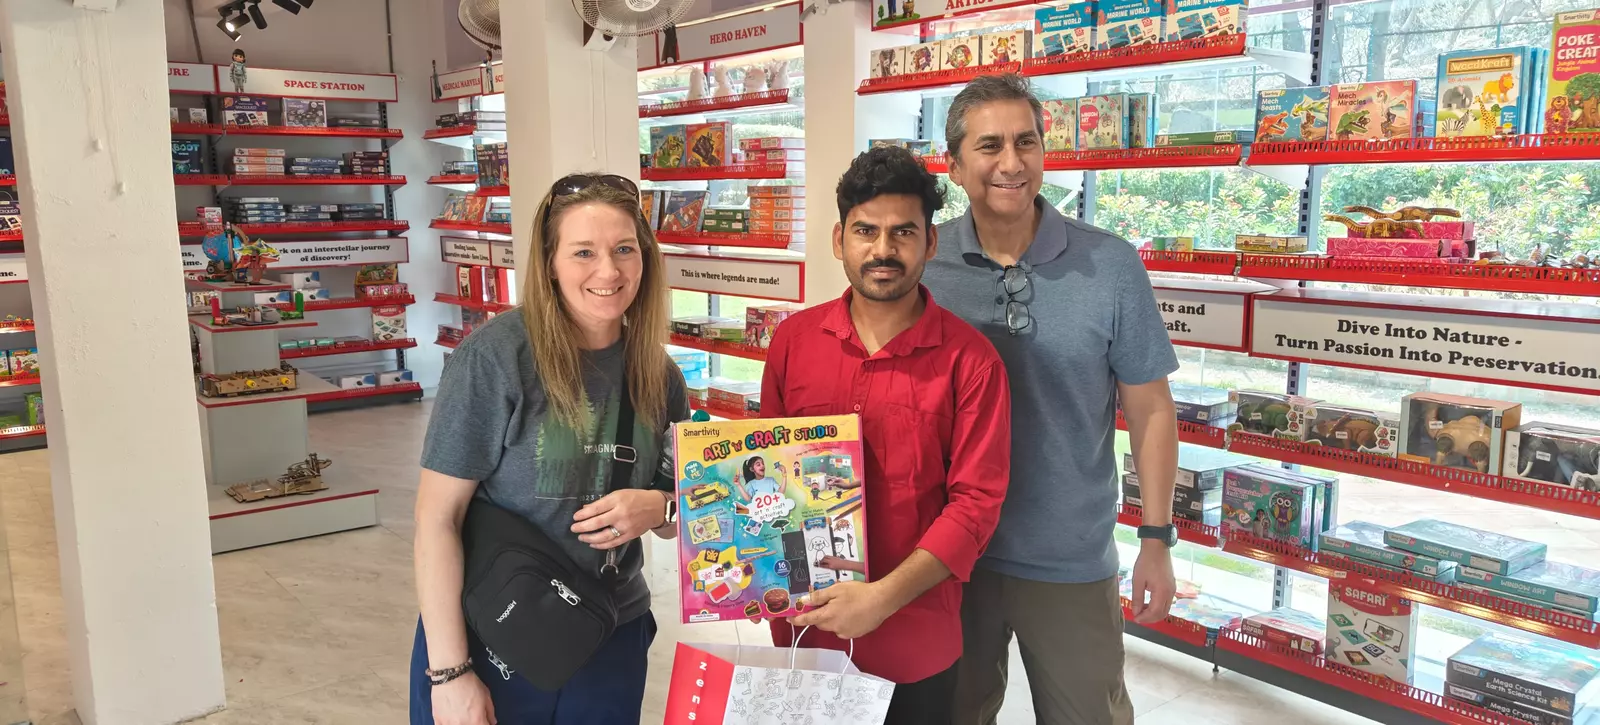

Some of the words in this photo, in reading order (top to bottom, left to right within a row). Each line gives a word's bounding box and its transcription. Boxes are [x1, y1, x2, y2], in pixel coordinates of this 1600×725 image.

[1107, 9, 1128, 19] MARINE
[1129, 7, 1151, 16] WORLD
[1042, 20, 1062, 28] MARINE
[1062, 18, 1082, 26] WORLD
[710, 31, 734, 44] HERO
[735, 25, 767, 40] HAVEN
[1558, 33, 1596, 47] POKE
[284, 80, 318, 89] SPACE
[320, 82, 365, 91] STATION
[314, 245, 360, 253] interstellar
[361, 244, 391, 252] journey
[681, 269, 694, 278] This
[701, 272, 721, 281] where
[721, 273, 746, 283] legends
[758, 277, 780, 286] made!
[1178, 303, 1206, 316] and
[1337, 319, 1380, 335] Dive
[1384, 323, 1428, 340] Into
[1432, 327, 1510, 347] Nature
[1275, 334, 1319, 351] Turn
[1323, 338, 1394, 359] Passion
[1399, 346, 1443, 363] Into
[683, 426, 720, 438] Smartivity
[703, 439, 731, 462] ART
[744, 425, 792, 450] CRAFT
[793, 424, 838, 441] STUDIO
[755, 494, 780, 509] 20+
[1355, 546, 1381, 557] WINDOW
[1382, 552, 1395, 560] ART
[1423, 544, 1450, 556] WINDOW
[1450, 551, 1464, 559] ART
[778, 561, 786, 569] 16
[1500, 580, 1531, 592] WINDOW
[1531, 588, 1547, 596] ART
[1345, 587, 1387, 607] SAFARI
[1242, 624, 1264, 636] SAFARI
[1486, 682, 1506, 693] Earth
[1507, 688, 1536, 701] Science
[1537, 696, 1548, 704] Kit
[1492, 677, 1514, 689] Mega
[1514, 684, 1543, 697] Crystal
[1490, 702, 1511, 713] Mega
[1511, 708, 1540, 722] Crystal
